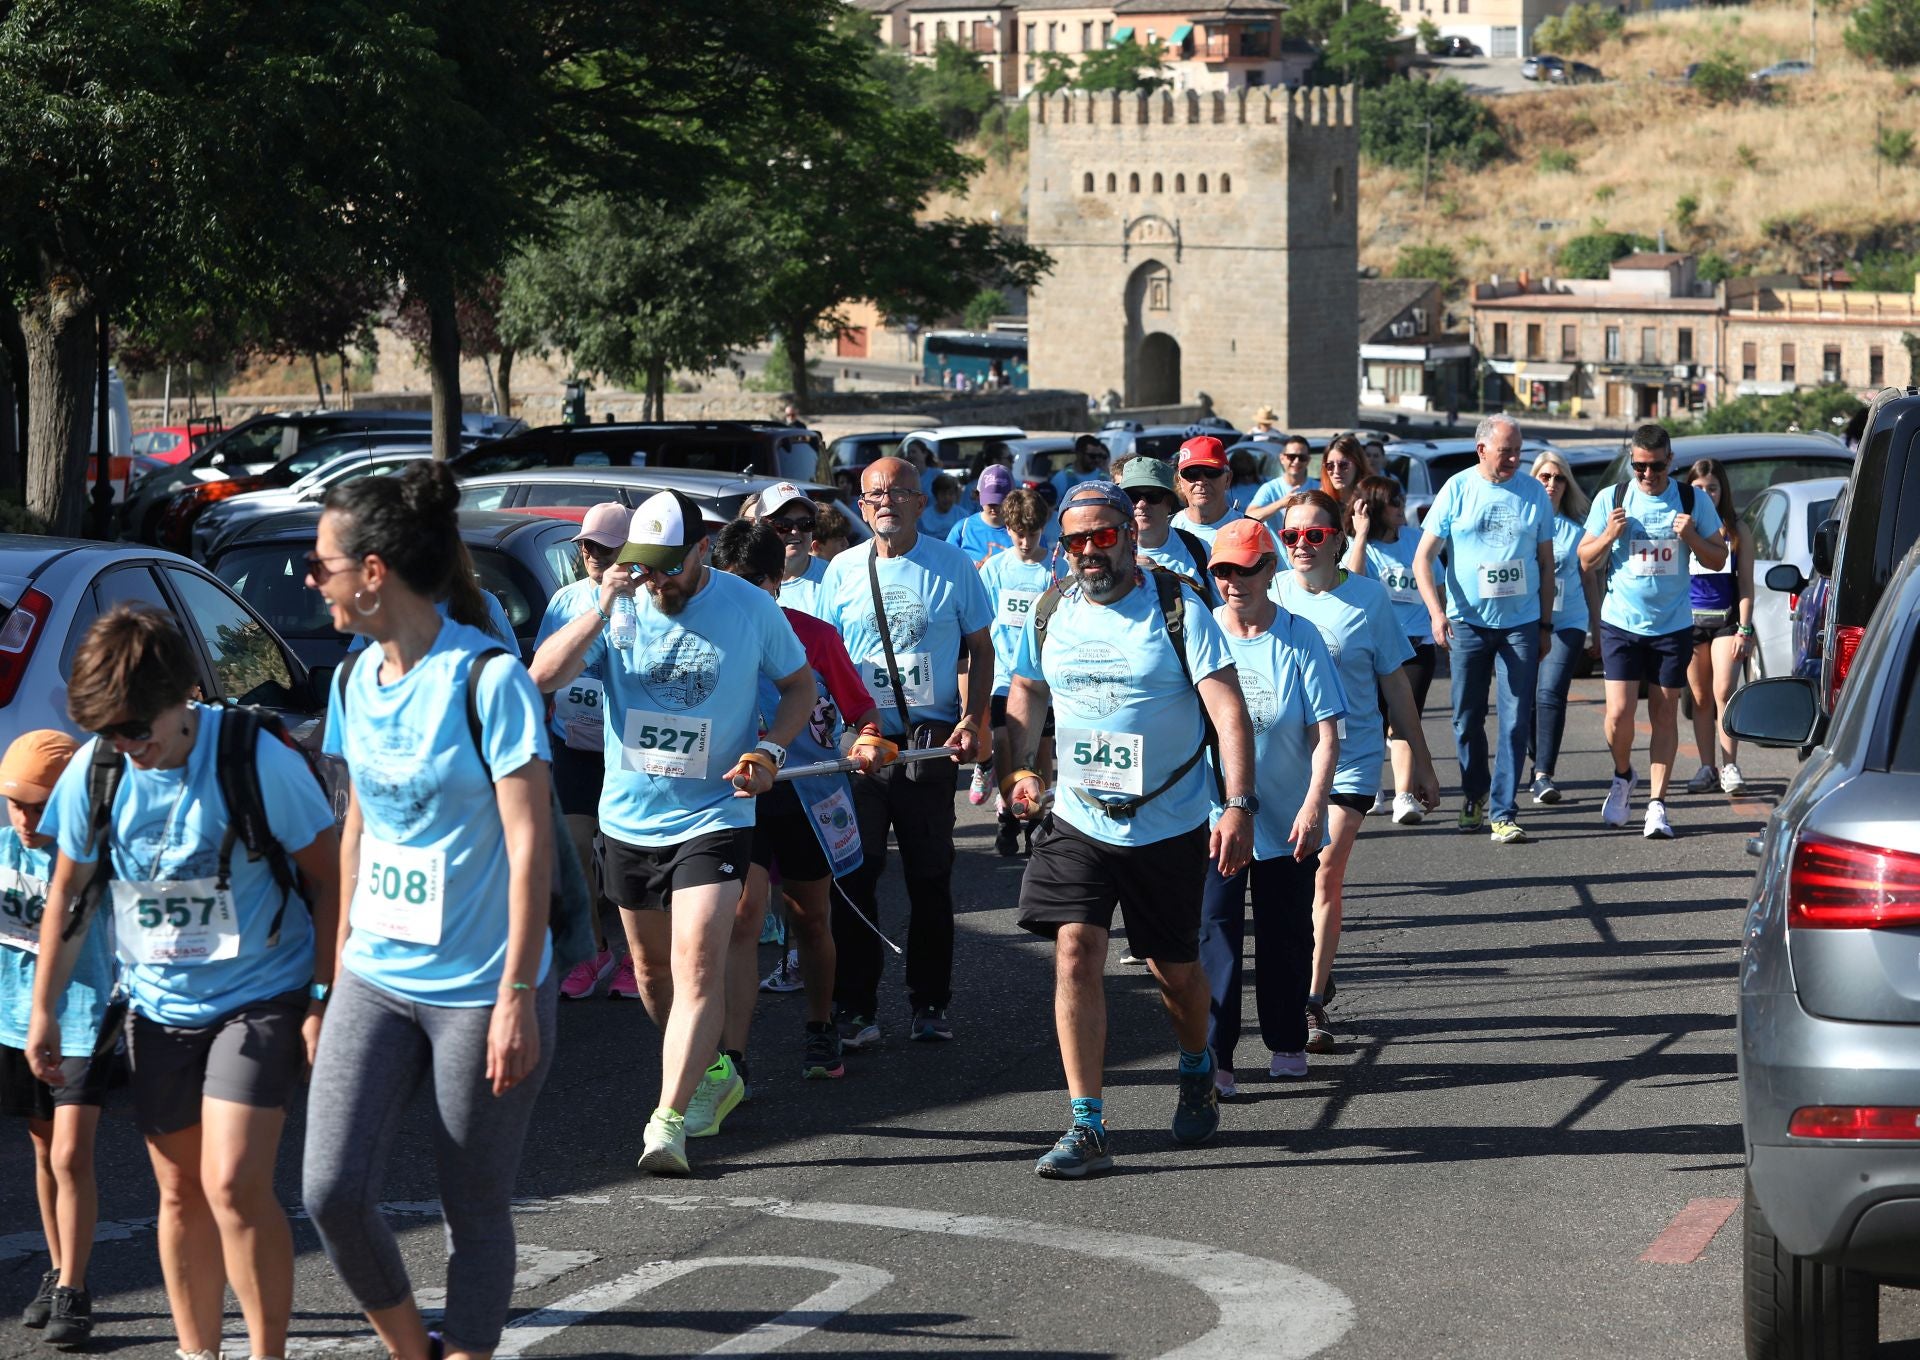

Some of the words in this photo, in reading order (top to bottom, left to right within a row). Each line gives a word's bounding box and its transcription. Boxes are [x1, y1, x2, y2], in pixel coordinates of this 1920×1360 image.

[1639, 548, 1672, 562] 110
[1388, 575, 1418, 590] 600
[1487, 568, 1520, 584] 599
[1007, 598, 1033, 613] 55
[568, 687, 604, 710] 58
[638, 725, 699, 755] 527
[699, 723, 707, 752] MARCHA
[646, 763, 684, 773] CIPRIANO
[1073, 742, 1132, 770] 543
[1083, 779, 1121, 788] CIPRIANO
[369, 862, 427, 905] 508
[429, 858, 437, 902] MARCHA
[1, 887, 46, 923] 56
[138, 897, 216, 929] 557
[217, 889, 230, 920] MARC
